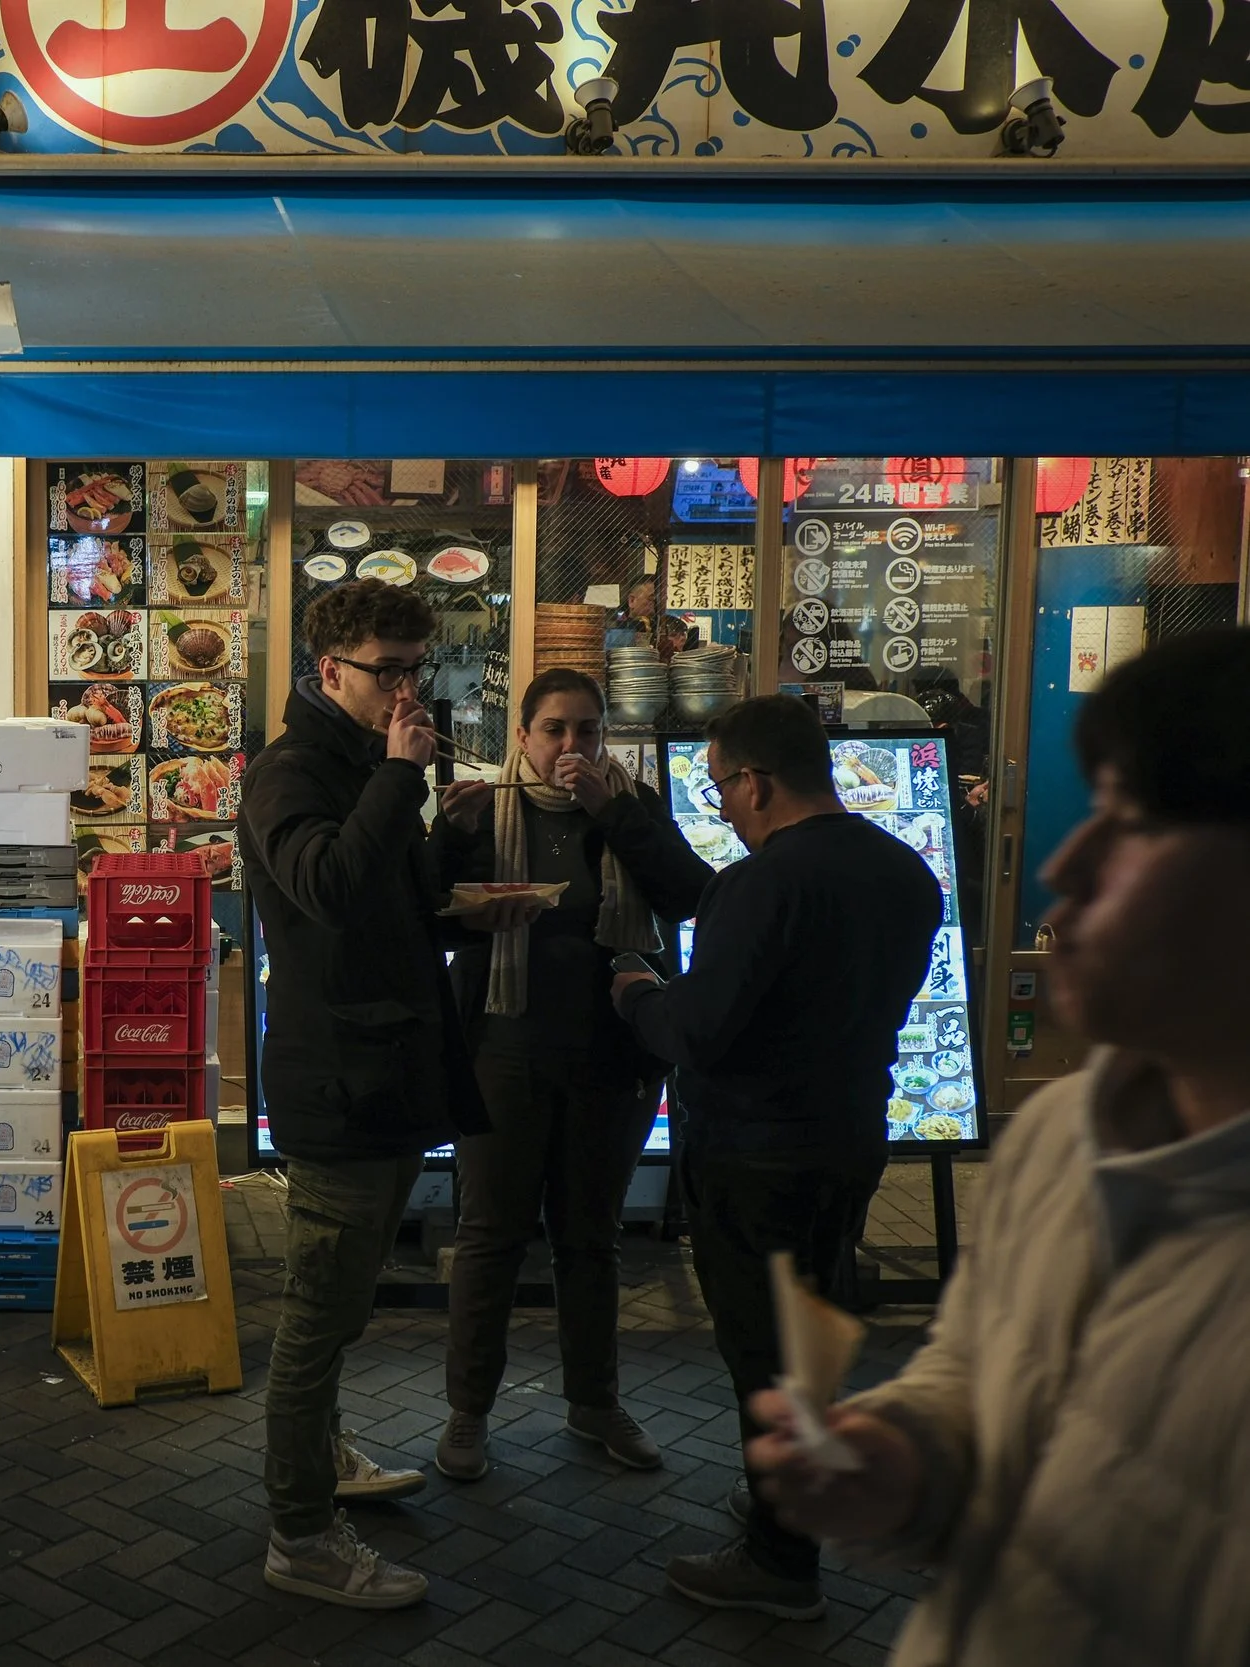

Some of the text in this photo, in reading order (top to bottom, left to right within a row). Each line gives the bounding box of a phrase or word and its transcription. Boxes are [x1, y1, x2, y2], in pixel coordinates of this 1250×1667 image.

[838, 483, 969, 504] 24時間営業
[833, 521, 864, 530] モバイル
[925, 523, 946, 532] Wi-Fi
[32, 993, 51, 1008] 24
[115, 1024, 174, 1043] Coca-Cola
[935, 1005, 967, 1048] 一品
[35, 1210, 54, 1225] 24
[122, 1255, 196, 1285] 禁煙
[129, 1285, 194, 1300] NO SMOKING
